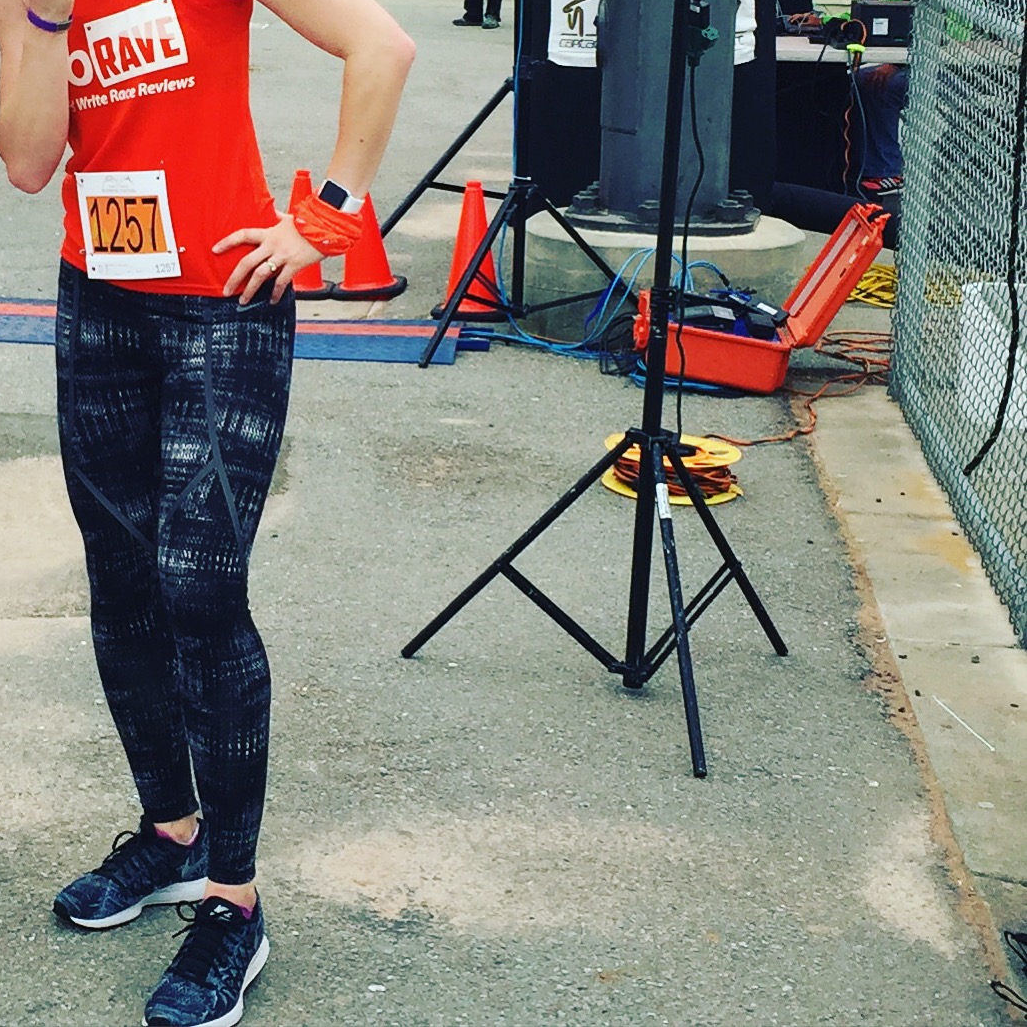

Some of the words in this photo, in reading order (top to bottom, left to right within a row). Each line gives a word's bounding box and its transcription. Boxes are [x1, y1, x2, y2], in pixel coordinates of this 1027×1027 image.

[93, 15, 181, 80] RAVE
[75, 94, 109, 111] Write
[109, 87, 137, 104] Race
[137, 75, 195, 97] Reviews
[90, 198, 157, 252] 1257
[155, 262, 176, 274] 1257
